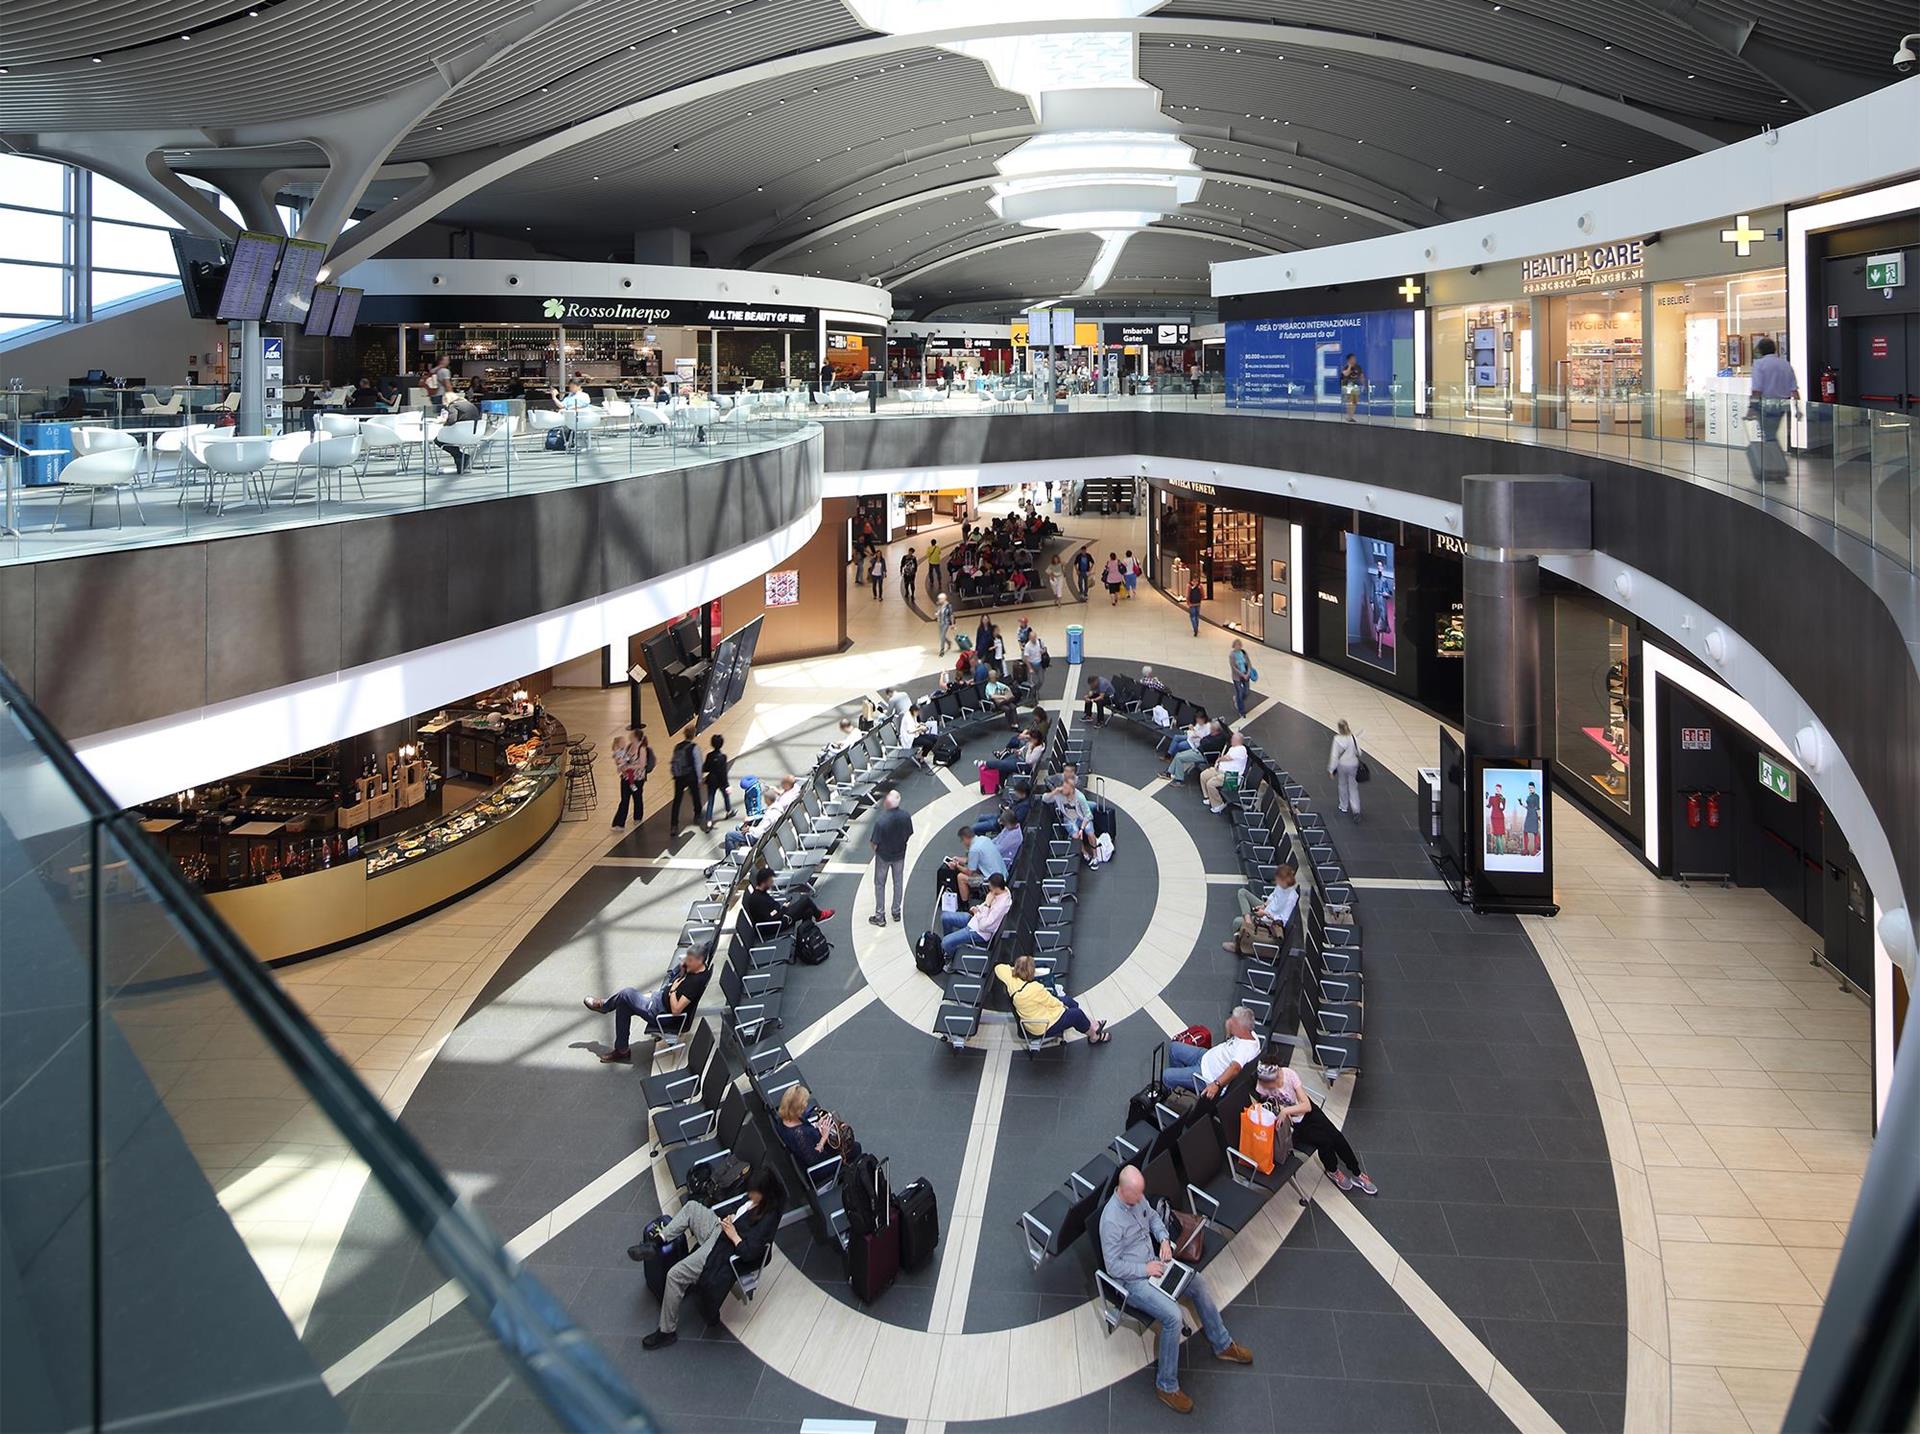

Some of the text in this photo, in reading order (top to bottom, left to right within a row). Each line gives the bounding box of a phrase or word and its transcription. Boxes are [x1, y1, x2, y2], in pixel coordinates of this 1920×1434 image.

[1521, 241, 1644, 281] HEALTH CARE
[1658, 295, 1690, 306] WE BELIEVE
[708, 310, 726, 320] ALL
[727, 310, 743, 321] THE
[744, 311, 777, 322] BEAUTY
[777, 313, 788, 322] OF
[1255, 318, 1361, 332] AREA D'IMBARCO INTERNAZIONALE
[1569, 320, 1619, 331] HYGIENE
[1123, 327, 1153, 335] Imbarchi
[1283, 332, 1300, 340] futuro
[1301, 331, 1317, 340] passa
[1325, 330, 1336, 338] qui
[265, 351, 281, 359] ADR
[1316, 343, 1341, 403] E
[1191, 482, 1216, 496] VENETA
